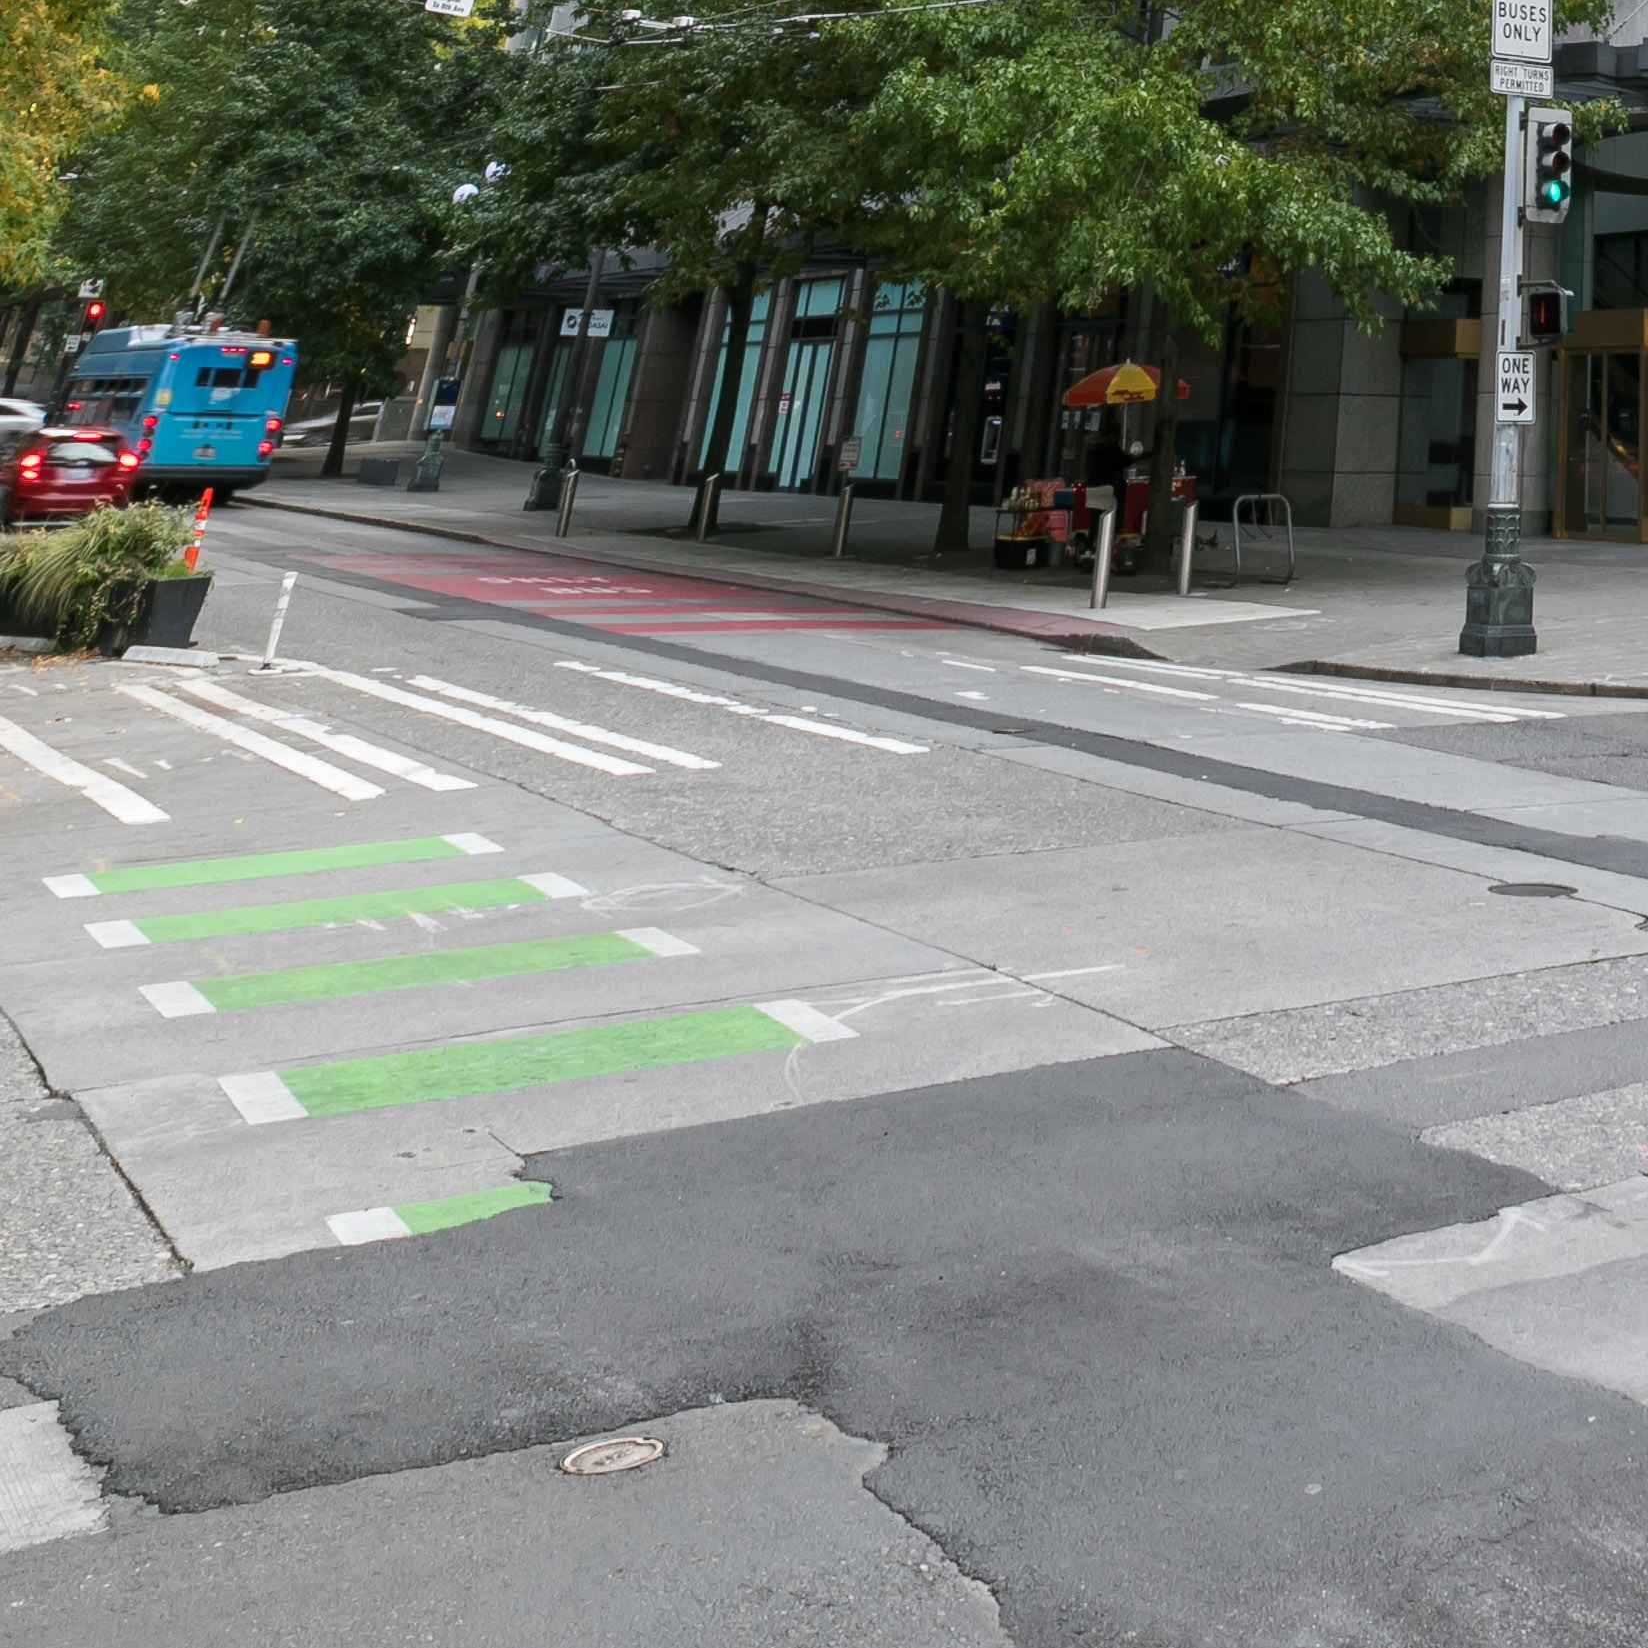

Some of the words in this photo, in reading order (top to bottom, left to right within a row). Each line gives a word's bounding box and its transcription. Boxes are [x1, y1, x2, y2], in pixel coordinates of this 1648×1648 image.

[1498, 1, 1547, 23] BUSES
[1503, 22, 1542, 43] ONLY
[1495, 65, 1518, 78] RIGHT
[1522, 67, 1549, 81] TURNS
[1500, 77, 1544, 93] PERMITTED
[1502, 357, 1530, 374] ONE
[1501, 377, 1530, 394] WAY
